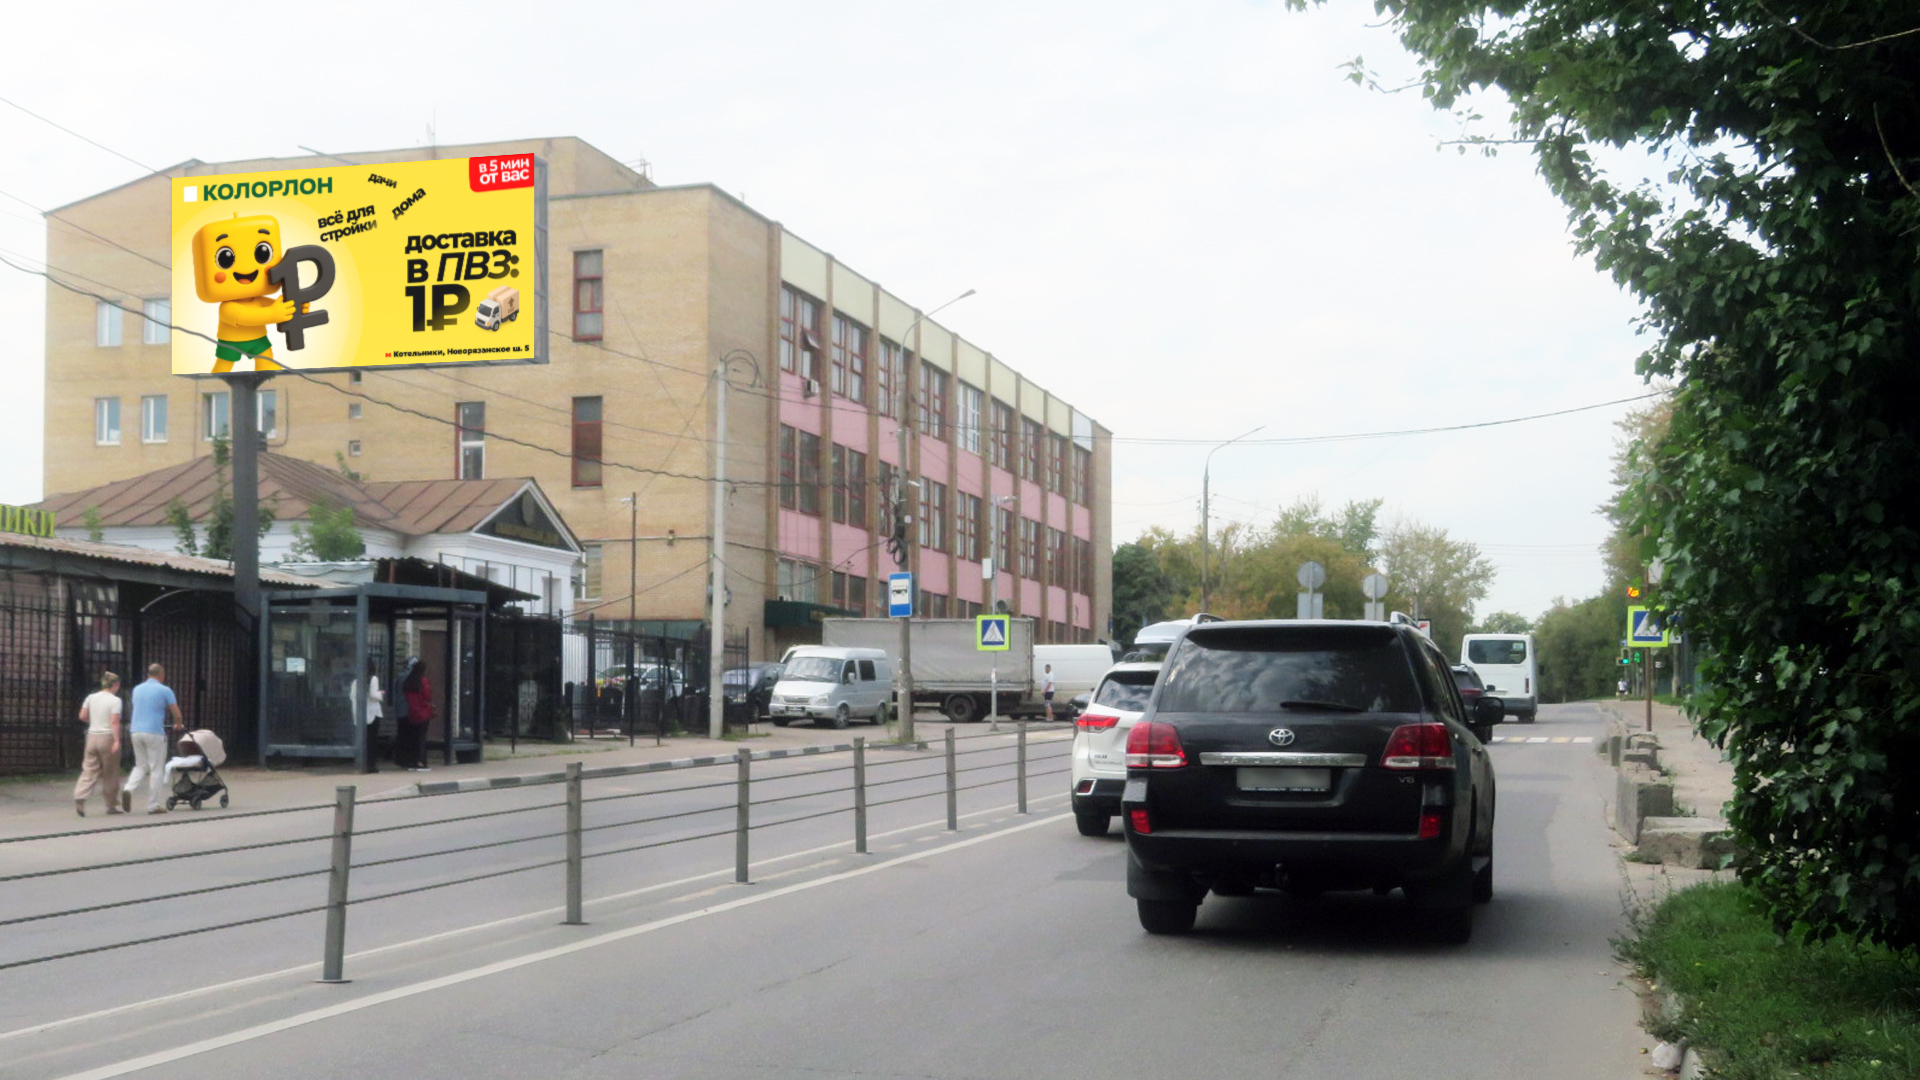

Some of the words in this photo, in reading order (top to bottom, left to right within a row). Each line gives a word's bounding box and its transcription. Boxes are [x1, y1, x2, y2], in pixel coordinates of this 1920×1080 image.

[489, 159, 498, 172] 5
[501, 168, 530, 182] вас
[203, 176, 333, 202] КОЛОРЛОН
[367, 173, 398, 189] дачи
[391, 187, 427, 221] дома
[317, 209, 344, 229] всё
[346, 204, 376, 223] для
[319, 219, 378, 242] стройки
[404, 229, 517, 254] доставка
[407, 258, 429, 283] в
[436, 249, 520, 282] ПВЗ:
[393, 349, 446, 358] Котельники,
[447, 345, 511, 355] Новорязанское
[524, 344, 530, 352] 5
